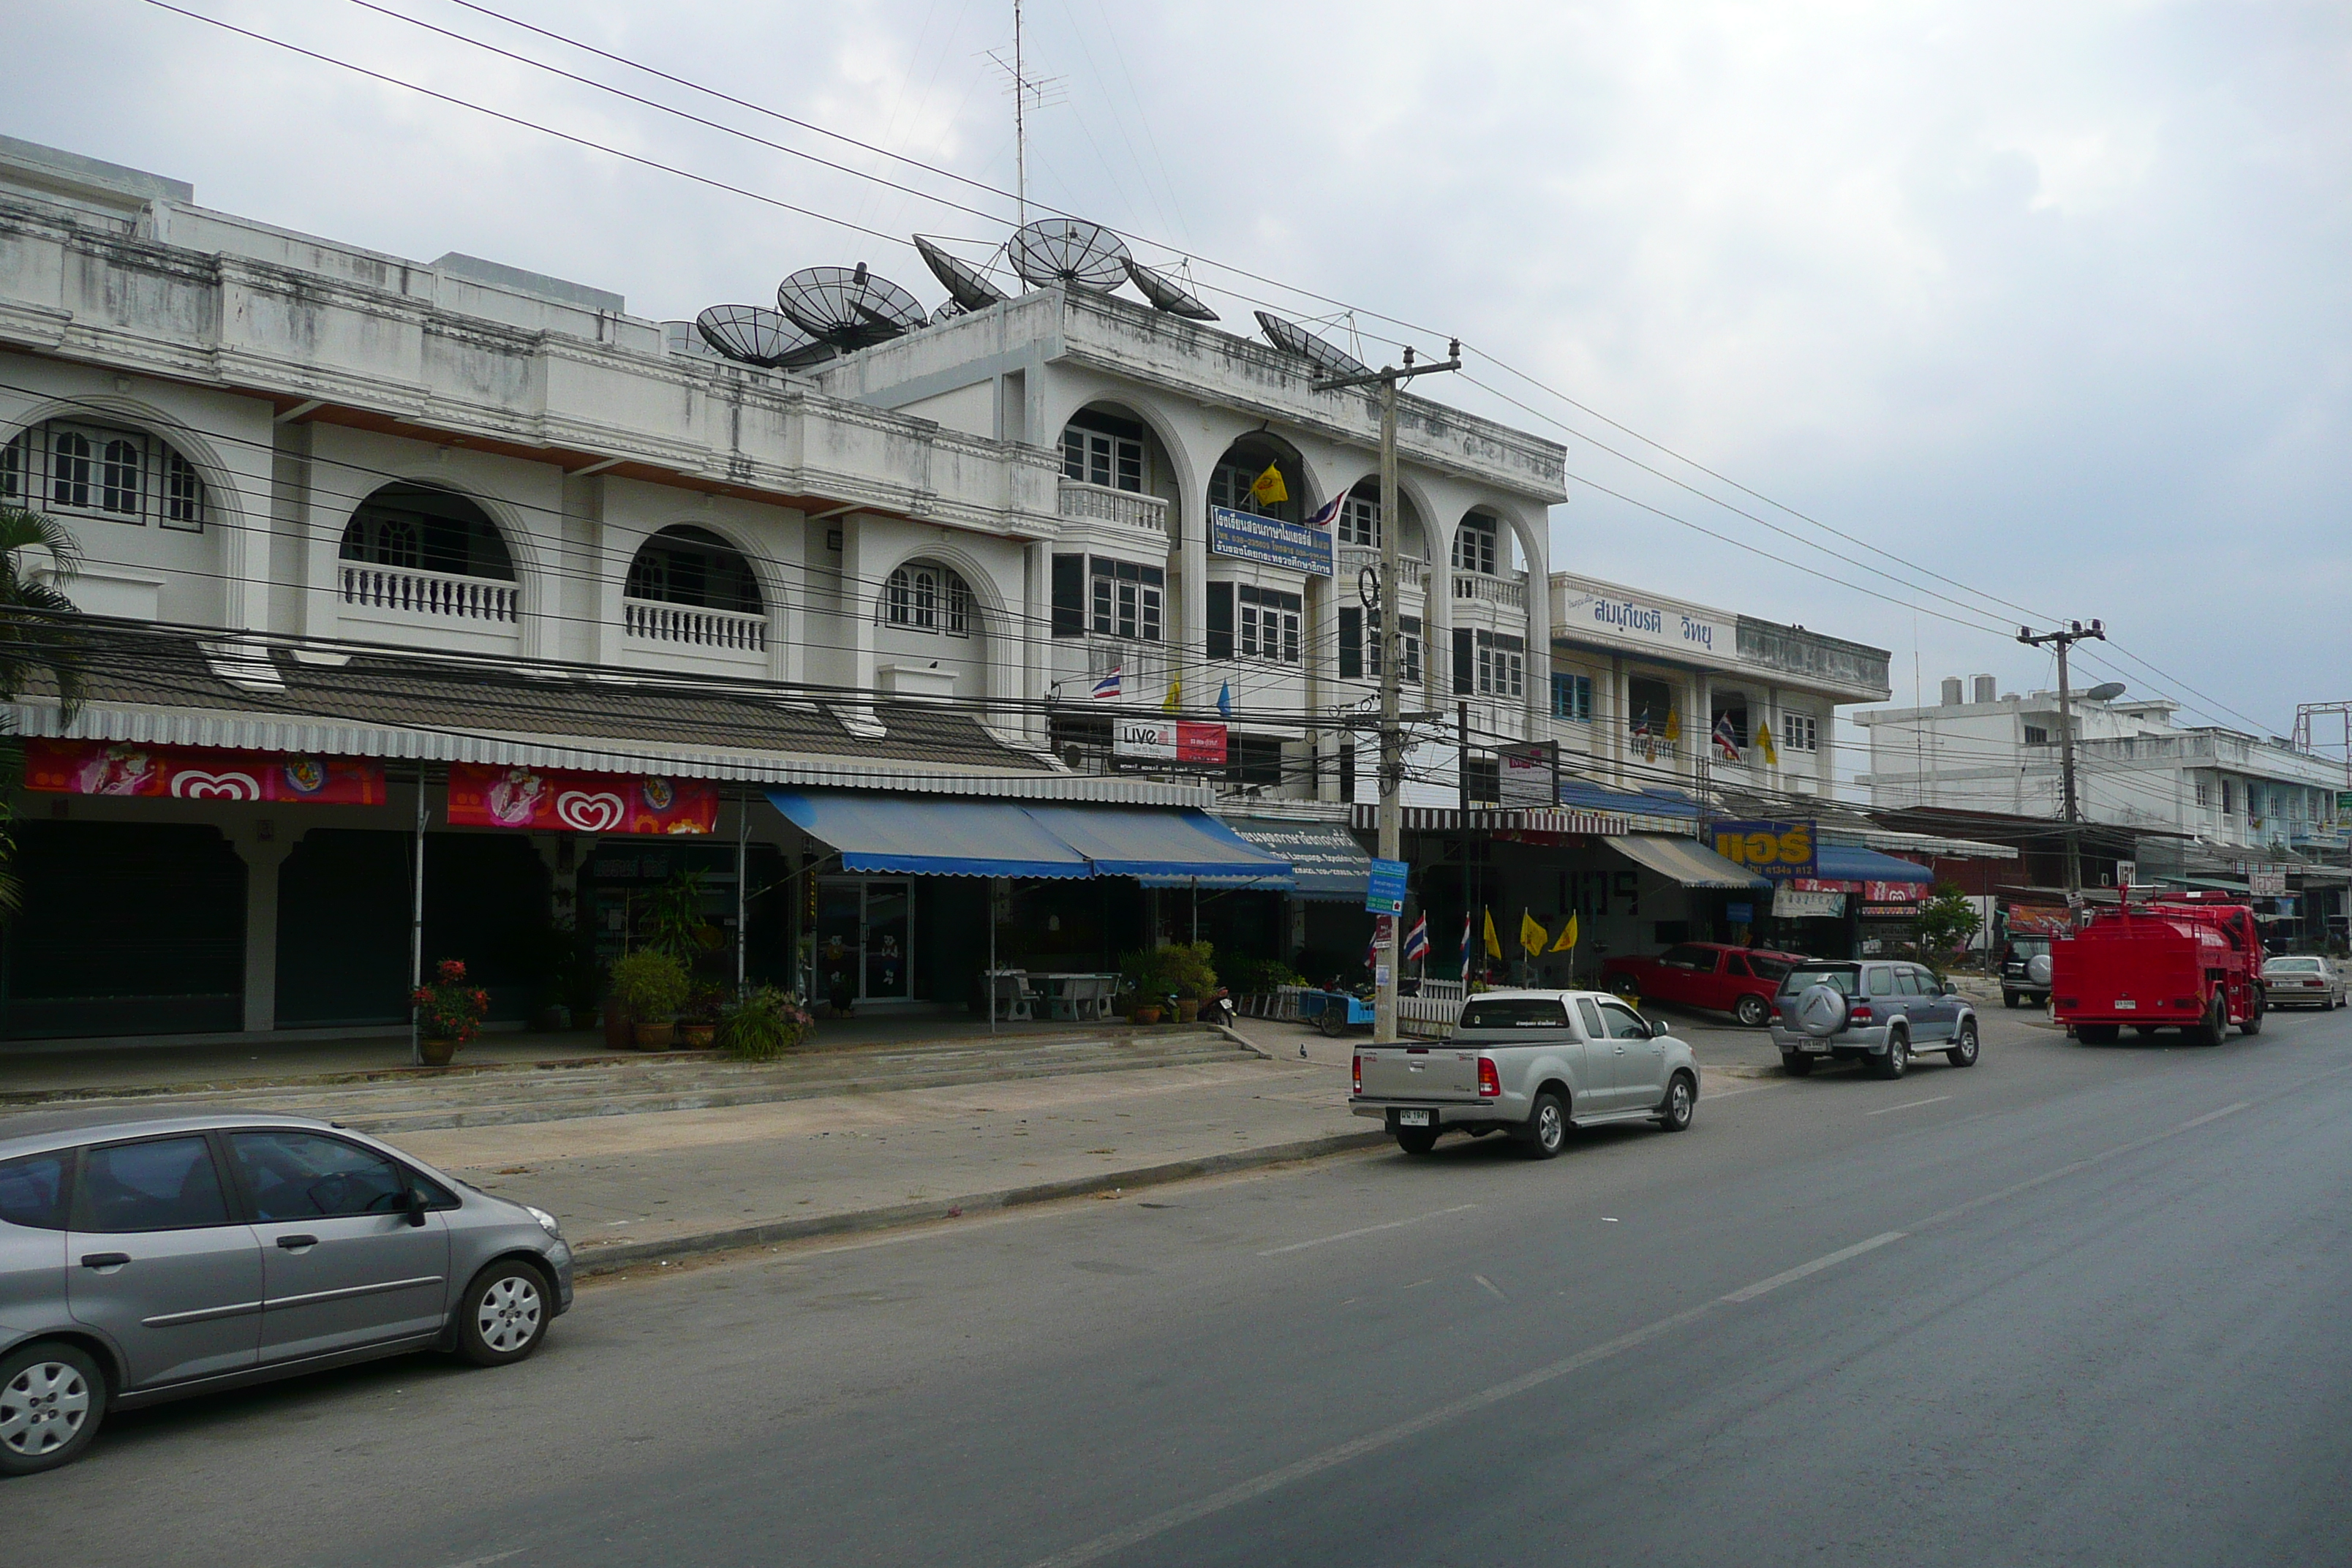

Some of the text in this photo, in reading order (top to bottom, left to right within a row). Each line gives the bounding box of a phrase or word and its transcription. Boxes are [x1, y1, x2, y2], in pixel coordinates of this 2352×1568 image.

[1594, 599, 1662, 633] สมเกียรติ
[1681, 616, 1712, 651] วิทยุ
[1716, 825, 1812, 864] แอร์
